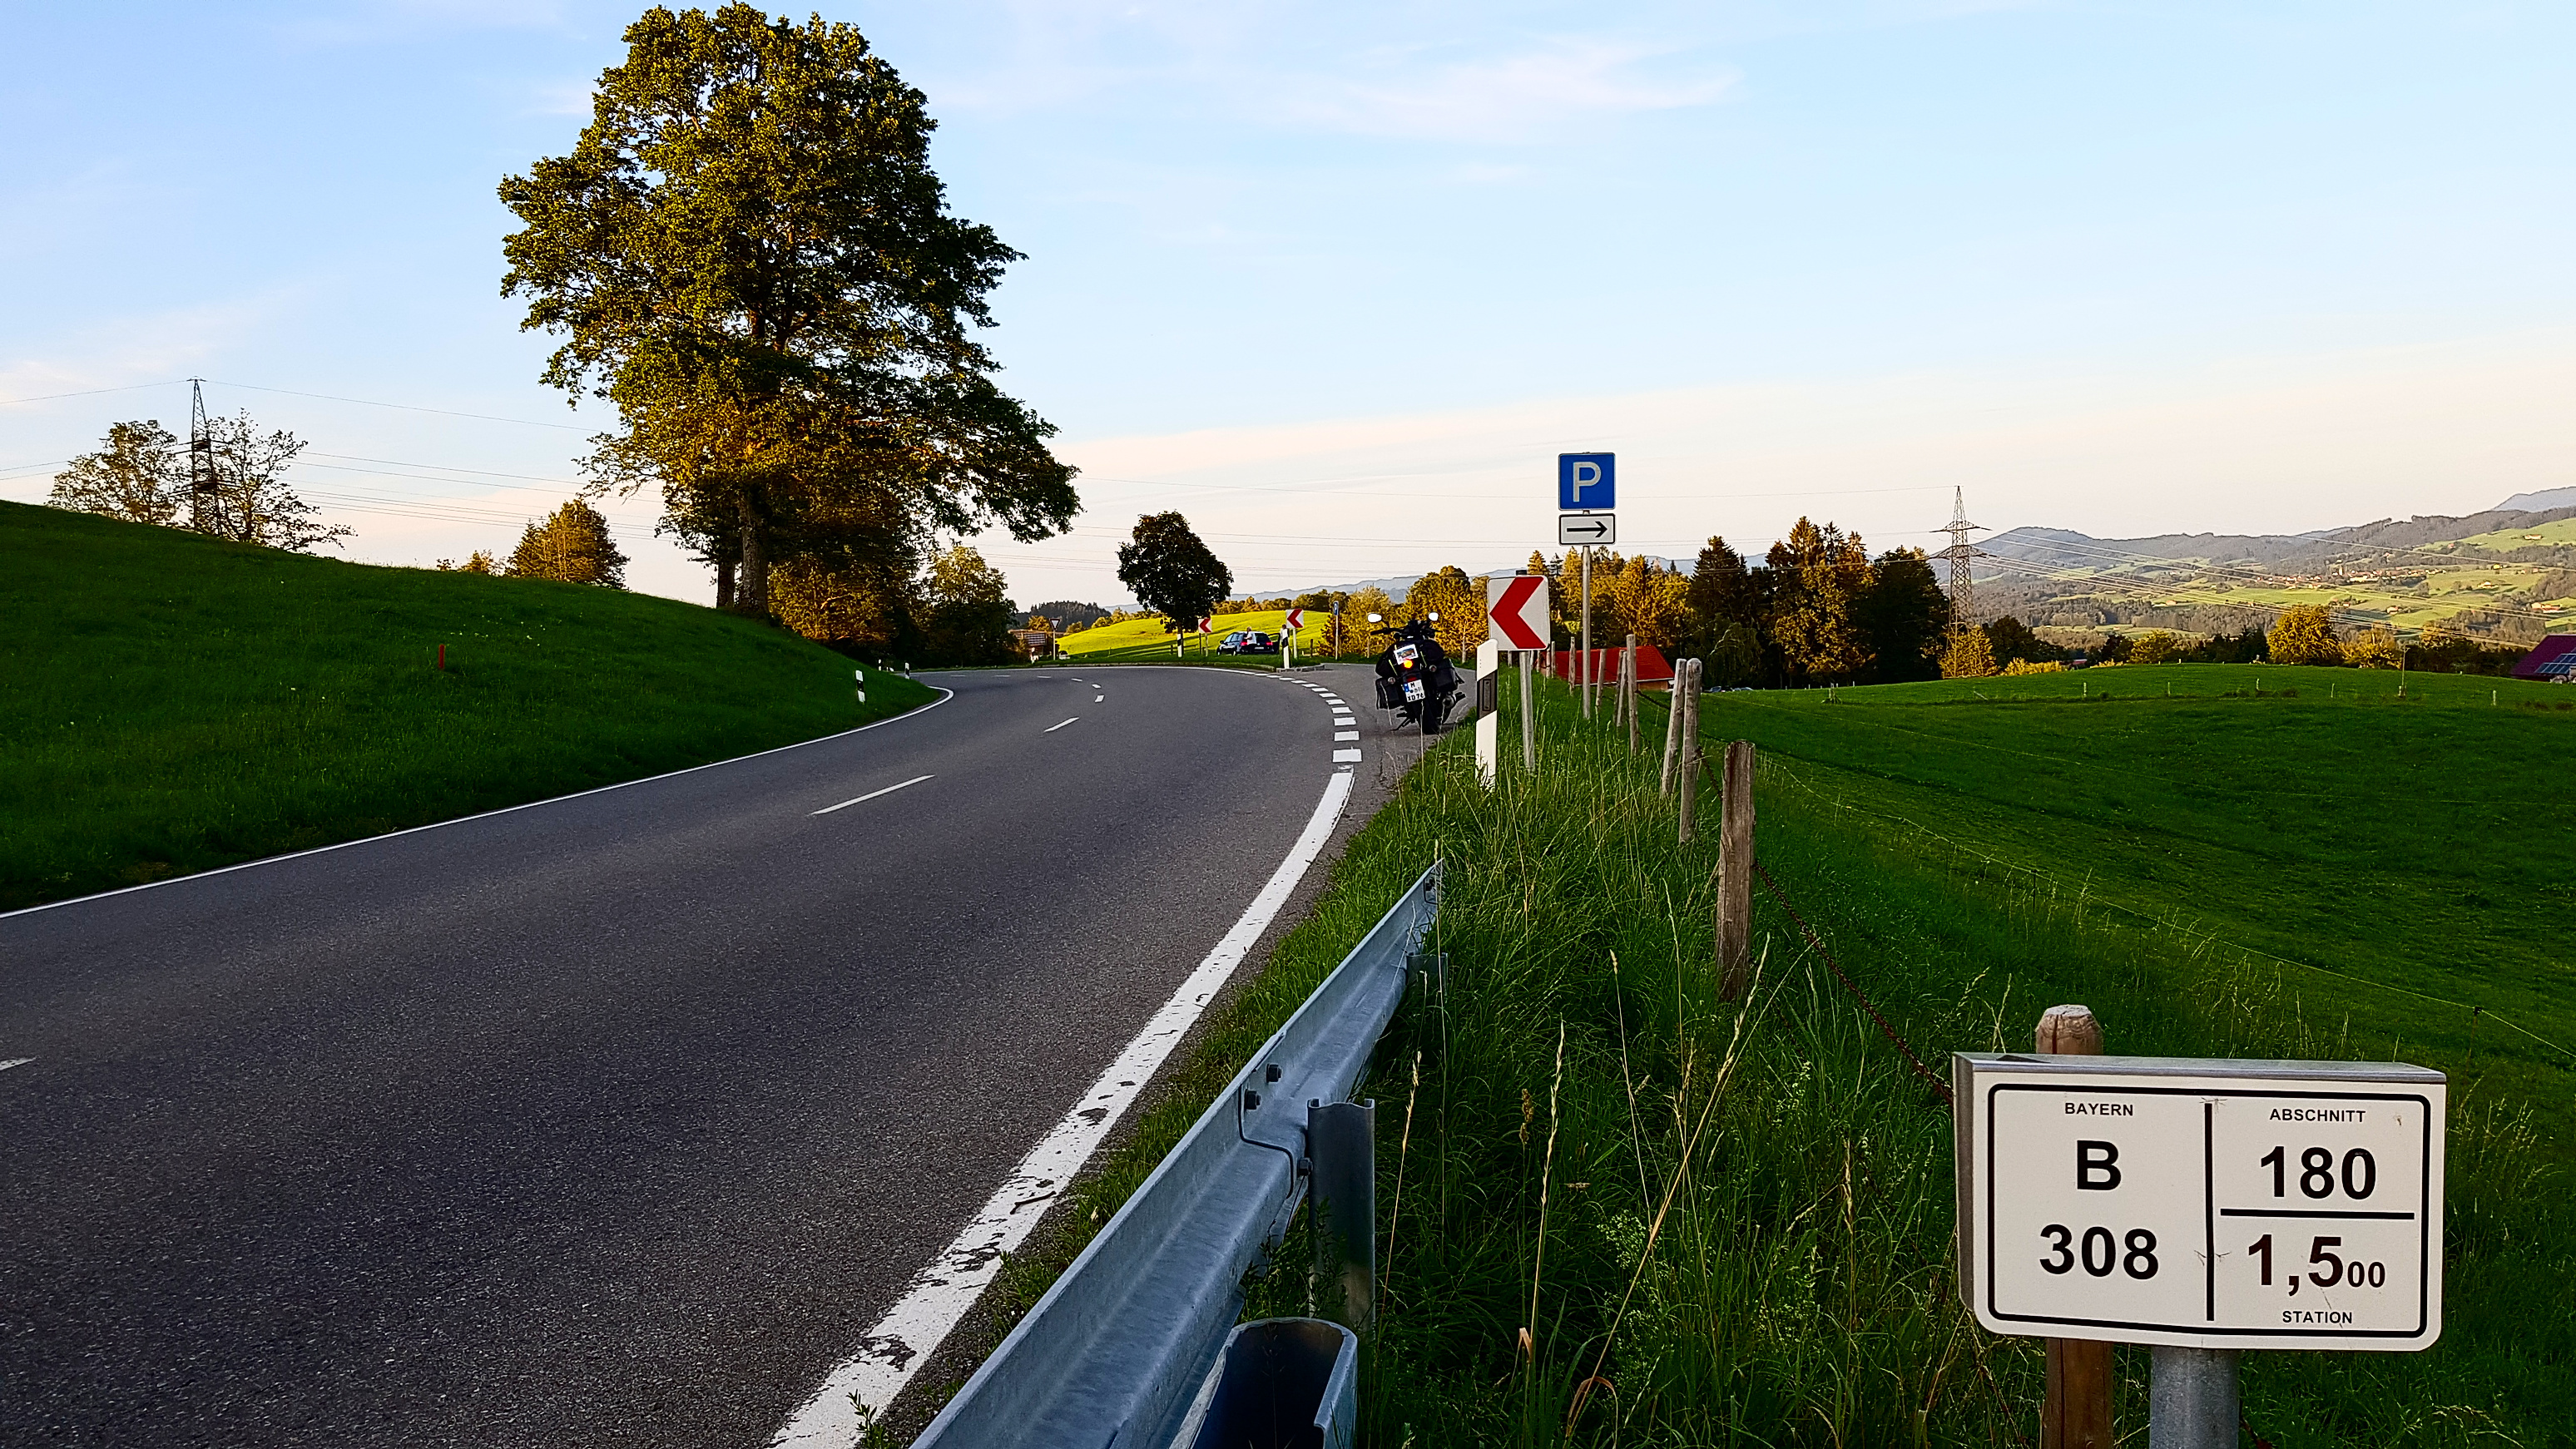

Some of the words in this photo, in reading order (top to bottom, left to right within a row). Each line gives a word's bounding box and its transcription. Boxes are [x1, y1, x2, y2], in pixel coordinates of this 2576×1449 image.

[1573, 462, 1602, 502] P
[2064, 1102, 2133, 1116] BAYERN
[2269, 1108, 2366, 1123] ABSCHNITT
[2076, 1140, 2122, 1191] B
[2260, 1145, 2376, 1200] 180
[2039, 1224, 2159, 1280] 308
[2248, 1234, 2386, 1297] 1,500
[2281, 1310, 2353, 1324] STATION
